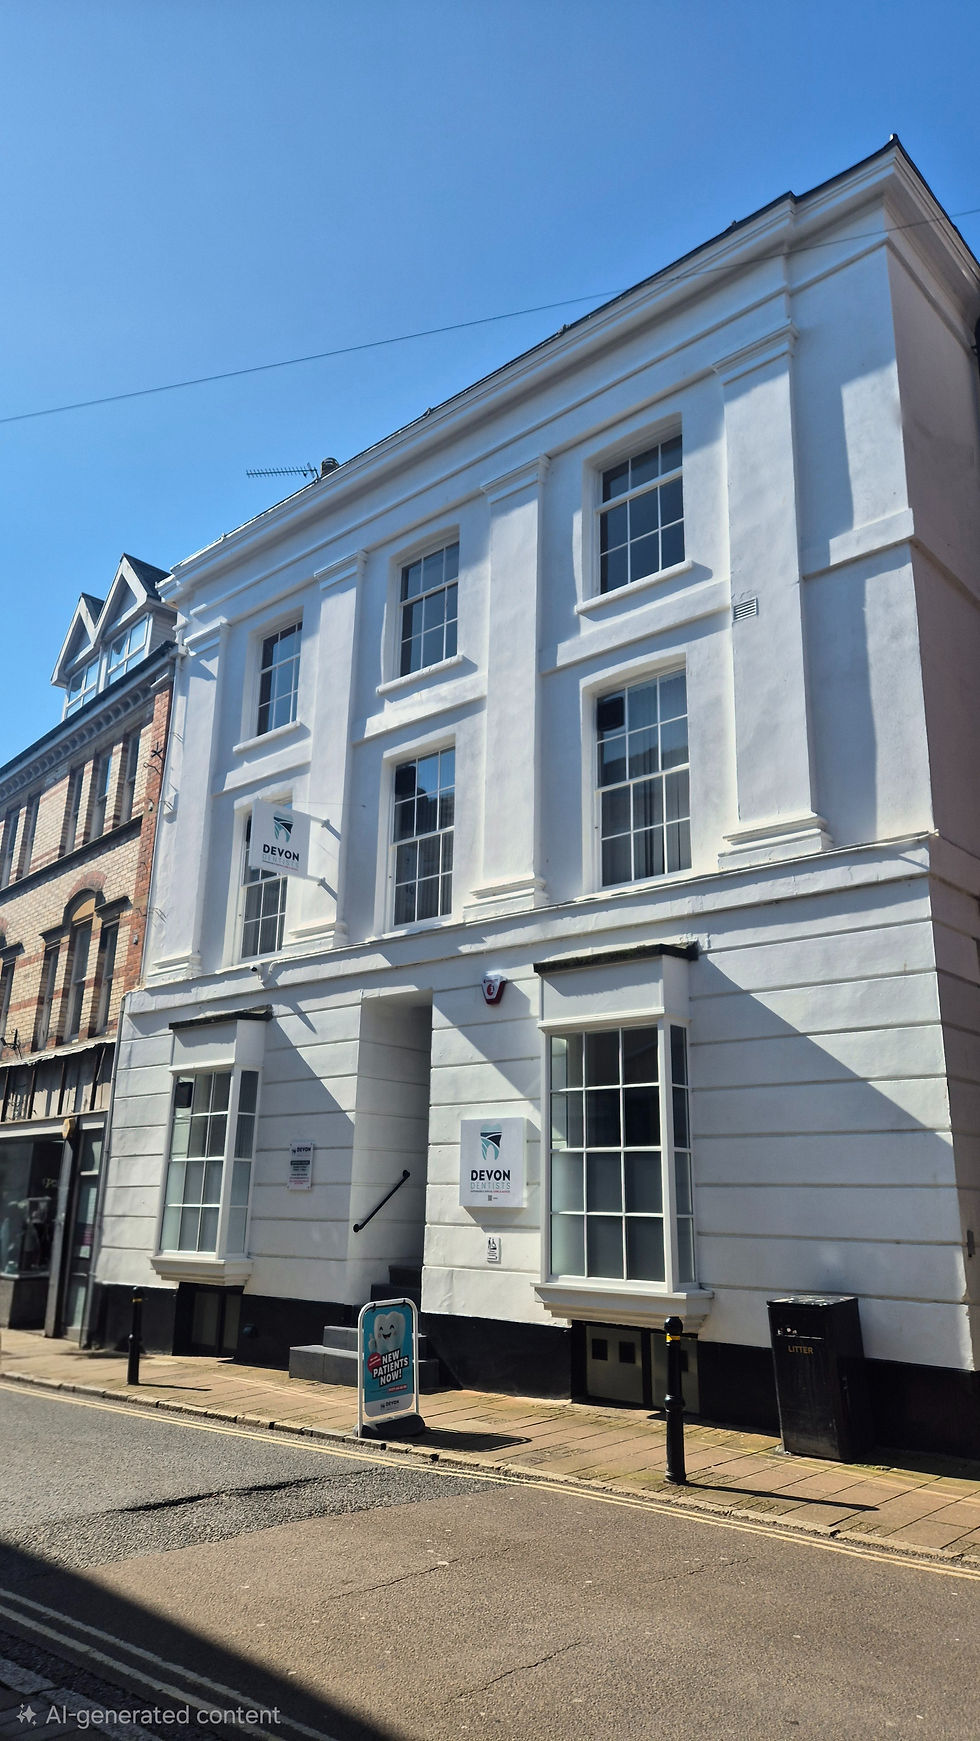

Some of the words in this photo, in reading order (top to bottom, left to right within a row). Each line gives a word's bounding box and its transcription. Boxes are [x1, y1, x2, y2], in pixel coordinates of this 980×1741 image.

[262, 843, 300, 862] DEVON
[470, 1169, 511, 1181] DEVON
[470, 1182, 511, 1190] DENTISTS
[382, 1350, 400, 1365] NEW
[787, 1345, 814, 1355] LITTER
[373, 1356, 409, 1378] PATIENTS
[380, 1368, 402, 1386] NOW!
